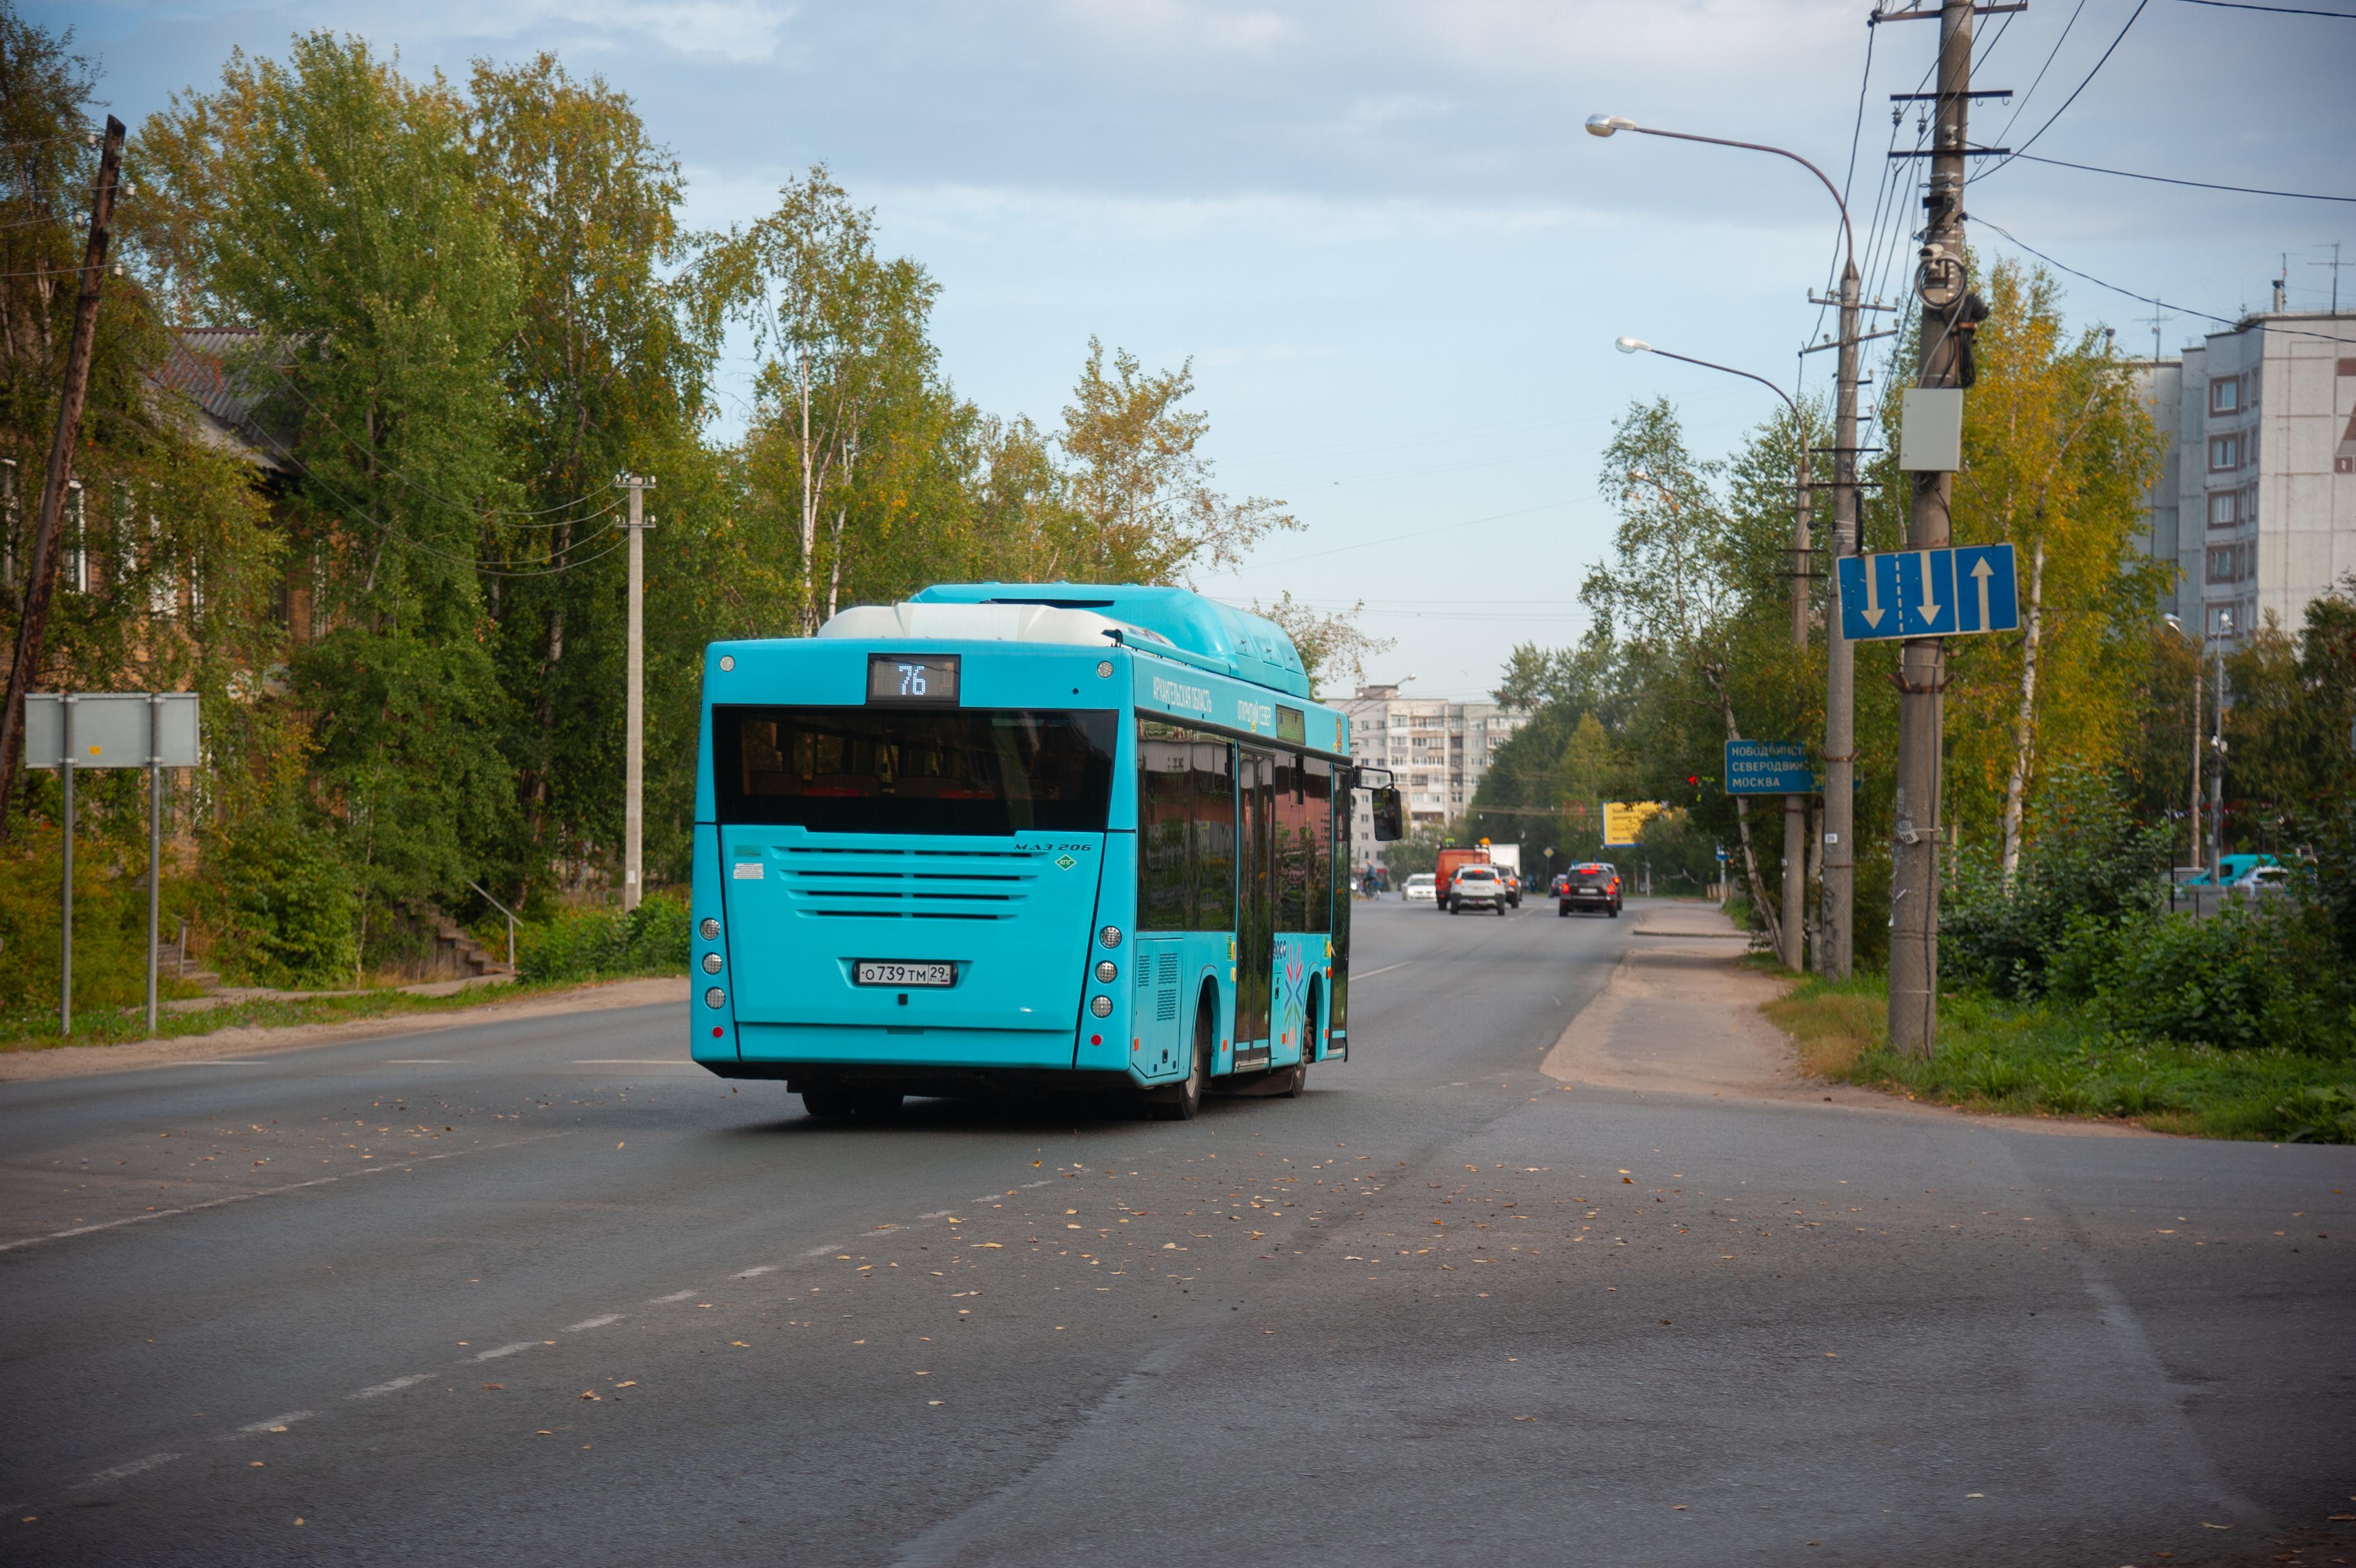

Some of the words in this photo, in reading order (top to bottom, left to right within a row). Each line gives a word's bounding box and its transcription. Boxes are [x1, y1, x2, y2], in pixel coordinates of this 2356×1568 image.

[899, 666, 926, 695] 76
[1153, 676, 1192, 709] АРХАНГЕЛЬСКАЯ
[1192, 687, 1212, 713] ОБЛАСТЬ
[1237, 699, 1259, 725] ОТКРЫТЫЙ
[1259, 706, 1271, 726] СЕВЕР
[1732, 777, 1780, 788] МОСКВА
[930, 967, 945, 978] 29
